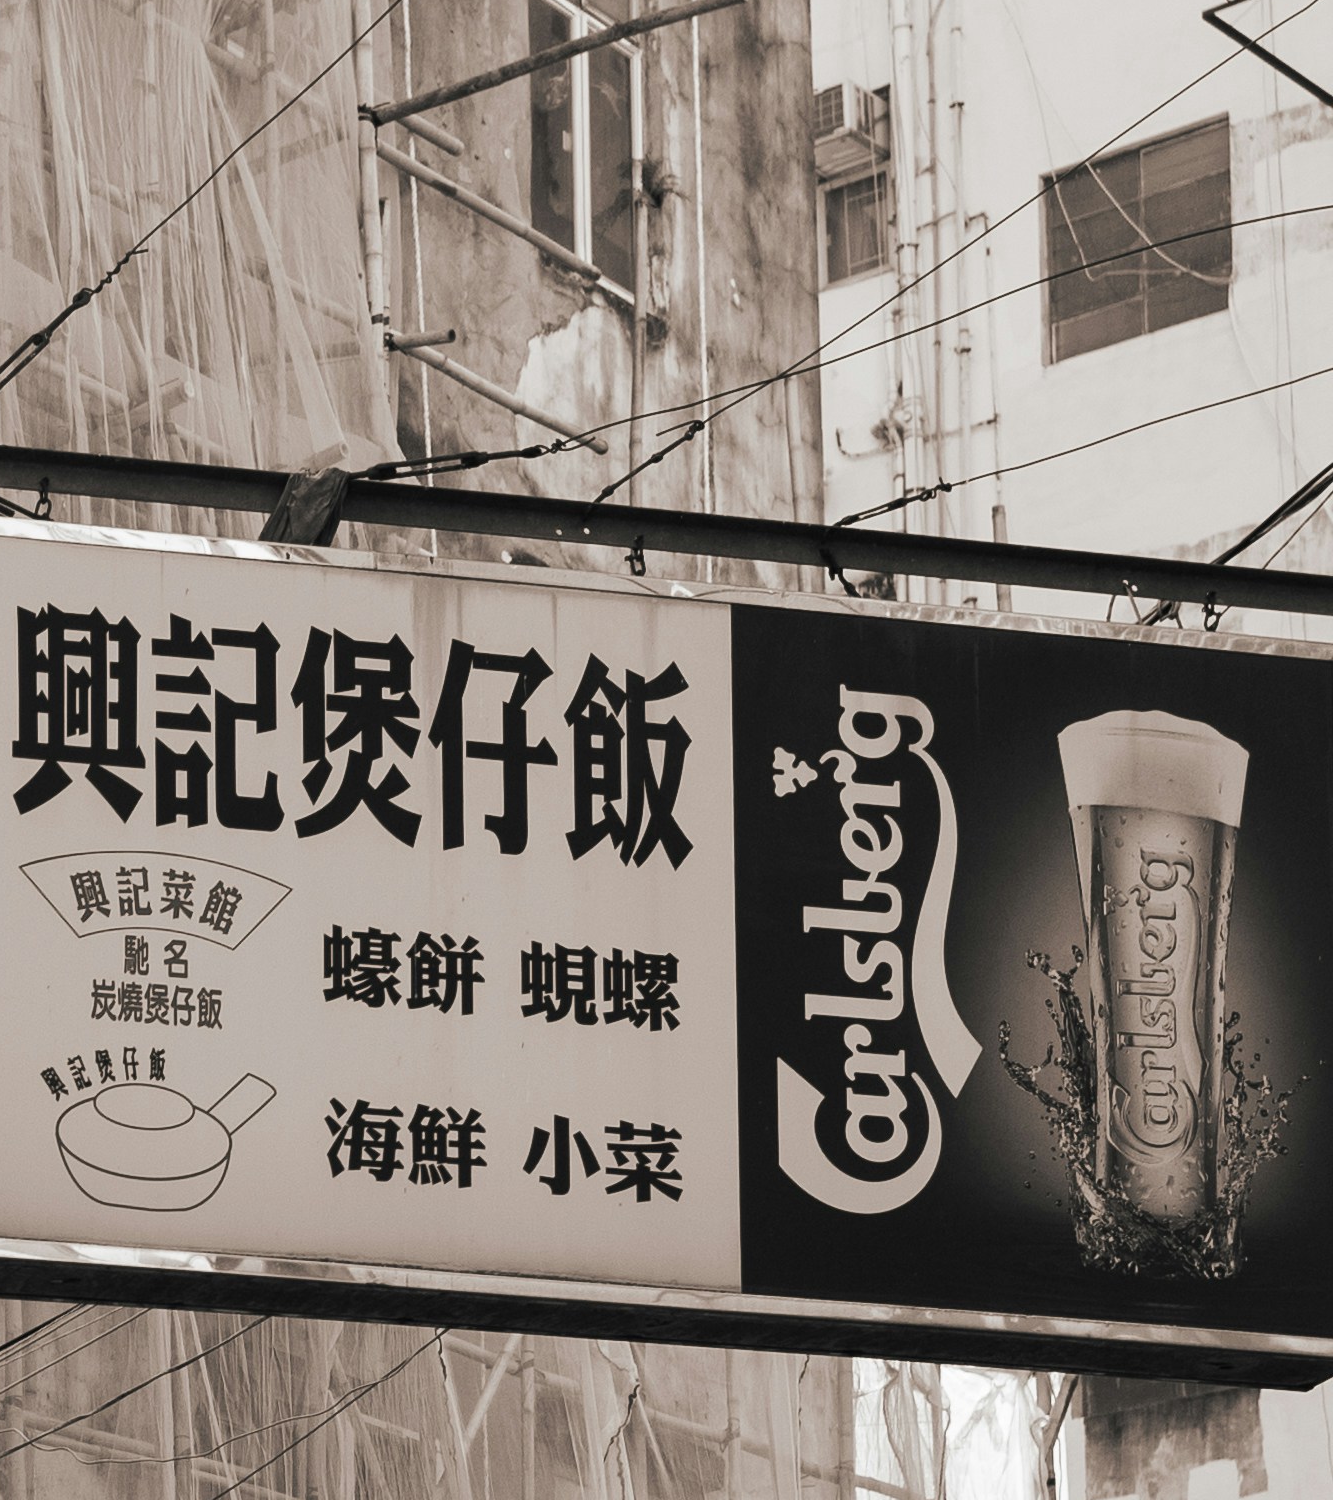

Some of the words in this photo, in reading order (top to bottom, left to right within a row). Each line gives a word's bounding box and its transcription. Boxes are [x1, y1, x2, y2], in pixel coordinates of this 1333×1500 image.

[12, 602, 694, 870] 興記煲仔飯
[70, 866, 242, 934] 興記菜館
[777, 684, 983, 1214] Carlsberg
[91, 979, 222, 1029] 炭燒煲仔飯
[124, 935, 189, 978] 馳名
[323, 924, 484, 1015] 蠔餅
[520, 941, 680, 1031] 蜆螺
[1107, 846, 1207, 1165] Carlsberg
[41, 1047, 165, 1100] 興記煲仔飯
[324, 1097, 487, 1188] 海鮮
[522, 1114, 683, 1203] 小菜
